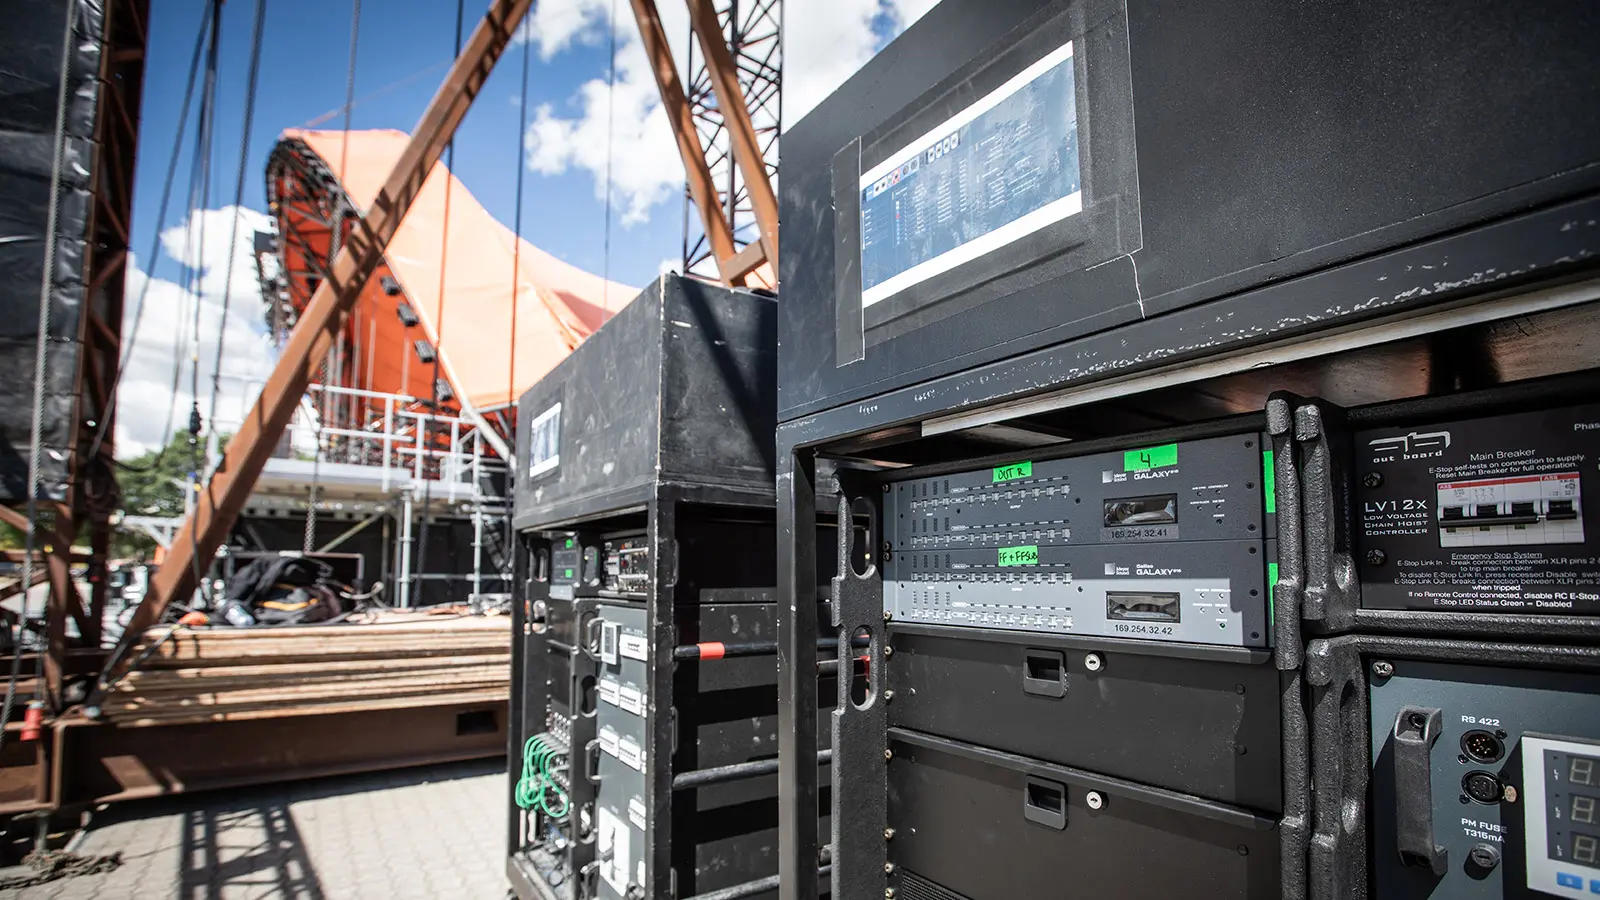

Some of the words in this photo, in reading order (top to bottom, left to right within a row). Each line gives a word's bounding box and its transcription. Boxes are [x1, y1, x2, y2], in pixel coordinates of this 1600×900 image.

[1403, 450, 1443, 460] board
[1470, 453, 1494, 462] Main
[1497, 449, 1536, 459] Breaker
[1429, 464, 1453, 474] E-Stop
[1455, 462, 1488, 471] self-tests
[1501, 457, 1544, 467] connection
[1459, 469, 1477, 477] Main
[1478, 467, 1508, 475] Breaker
[1536, 462, 1577, 471] operation.
[998, 468, 1014, 480] OUT
[1133, 470, 1171, 480] GALAXY
[1111, 529, 1168, 538] 169.254.32.41
[1494, 552, 1511, 560] Stop
[1513, 552, 1543, 560] System
[1569, 557, 1587, 565] pins
[1433, 571, 1457, 579] E-Stop
[1394, 577, 1417, 585] E-Stop
[1575, 578, 1594, 586] pins
[1493, 584, 1523, 592] tripped.
[1500, 599, 1525, 607] Green
[1535, 600, 1572, 608] Disabled
[1114, 624, 1173, 635] 169.254.32.42
[1461, 715, 1476, 724] RS
[1478, 716, 1500, 727] 422
[1461, 818, 1477, 827] PM
[1479, 820, 1508, 834] FUSE
[1464, 828, 1505, 844] T315mA
